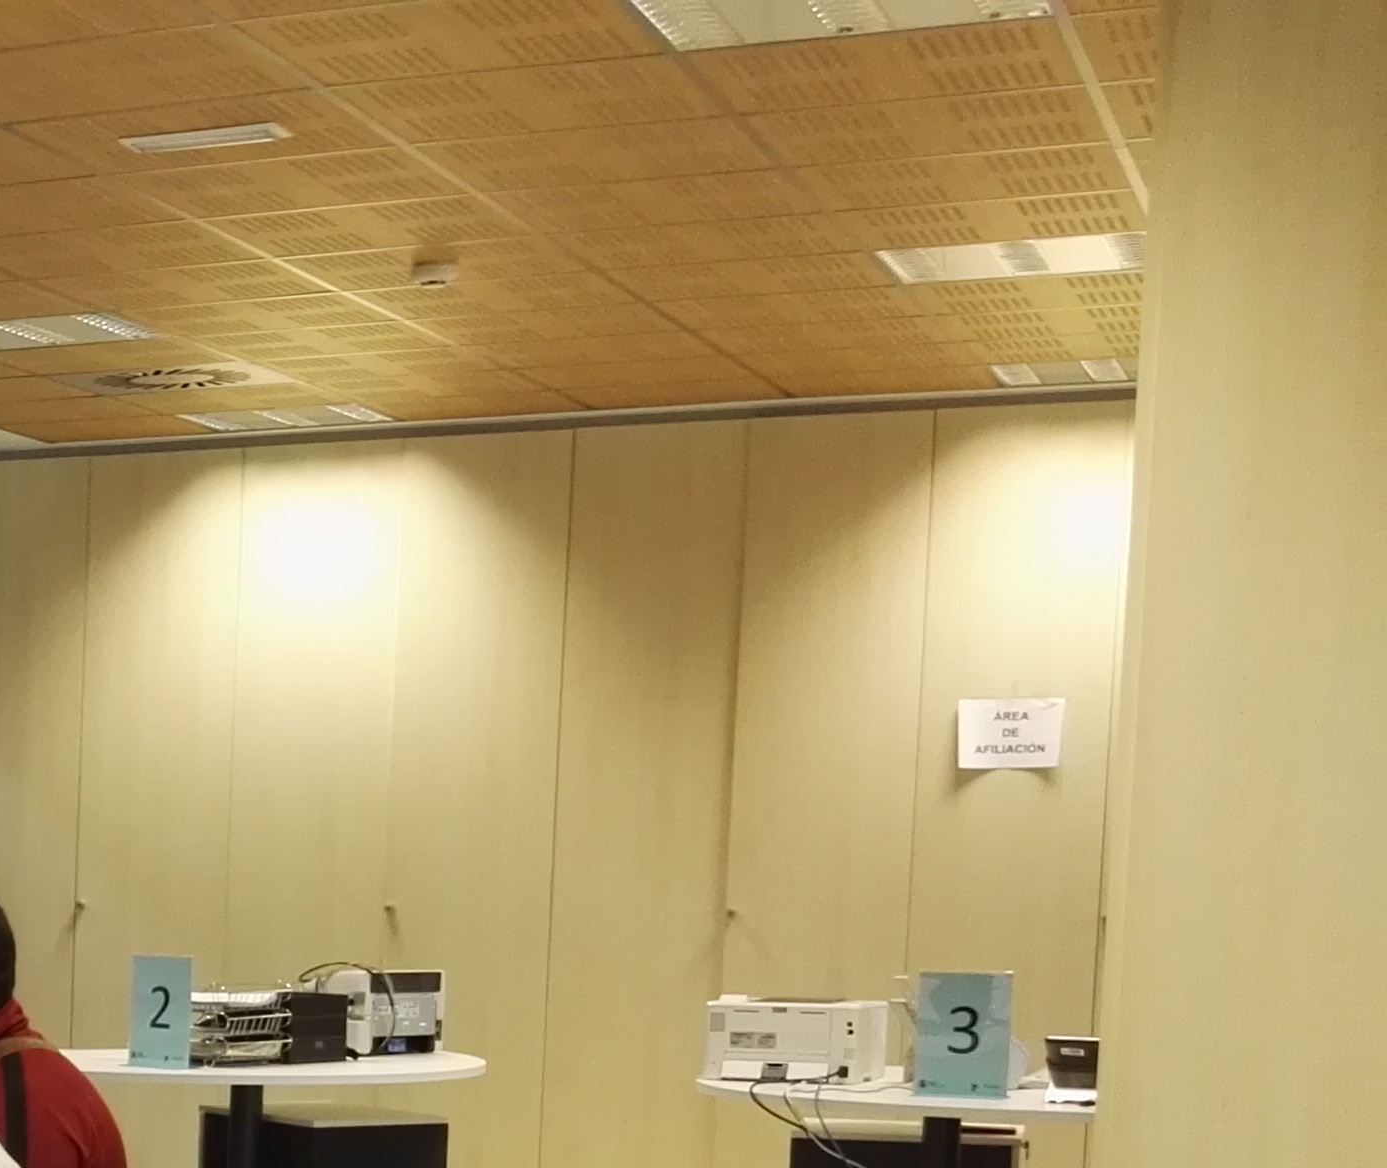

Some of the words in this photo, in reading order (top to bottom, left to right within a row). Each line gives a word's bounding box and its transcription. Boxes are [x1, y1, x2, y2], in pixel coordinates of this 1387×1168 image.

[993, 710, 1030, 721] ÁREA
[1001, 728, 1019, 738] DE
[974, 742, 1046, 754] AFILIACIÓN
[150, 985, 171, 1029] 2
[946, 1006, 980, 1054] 3
